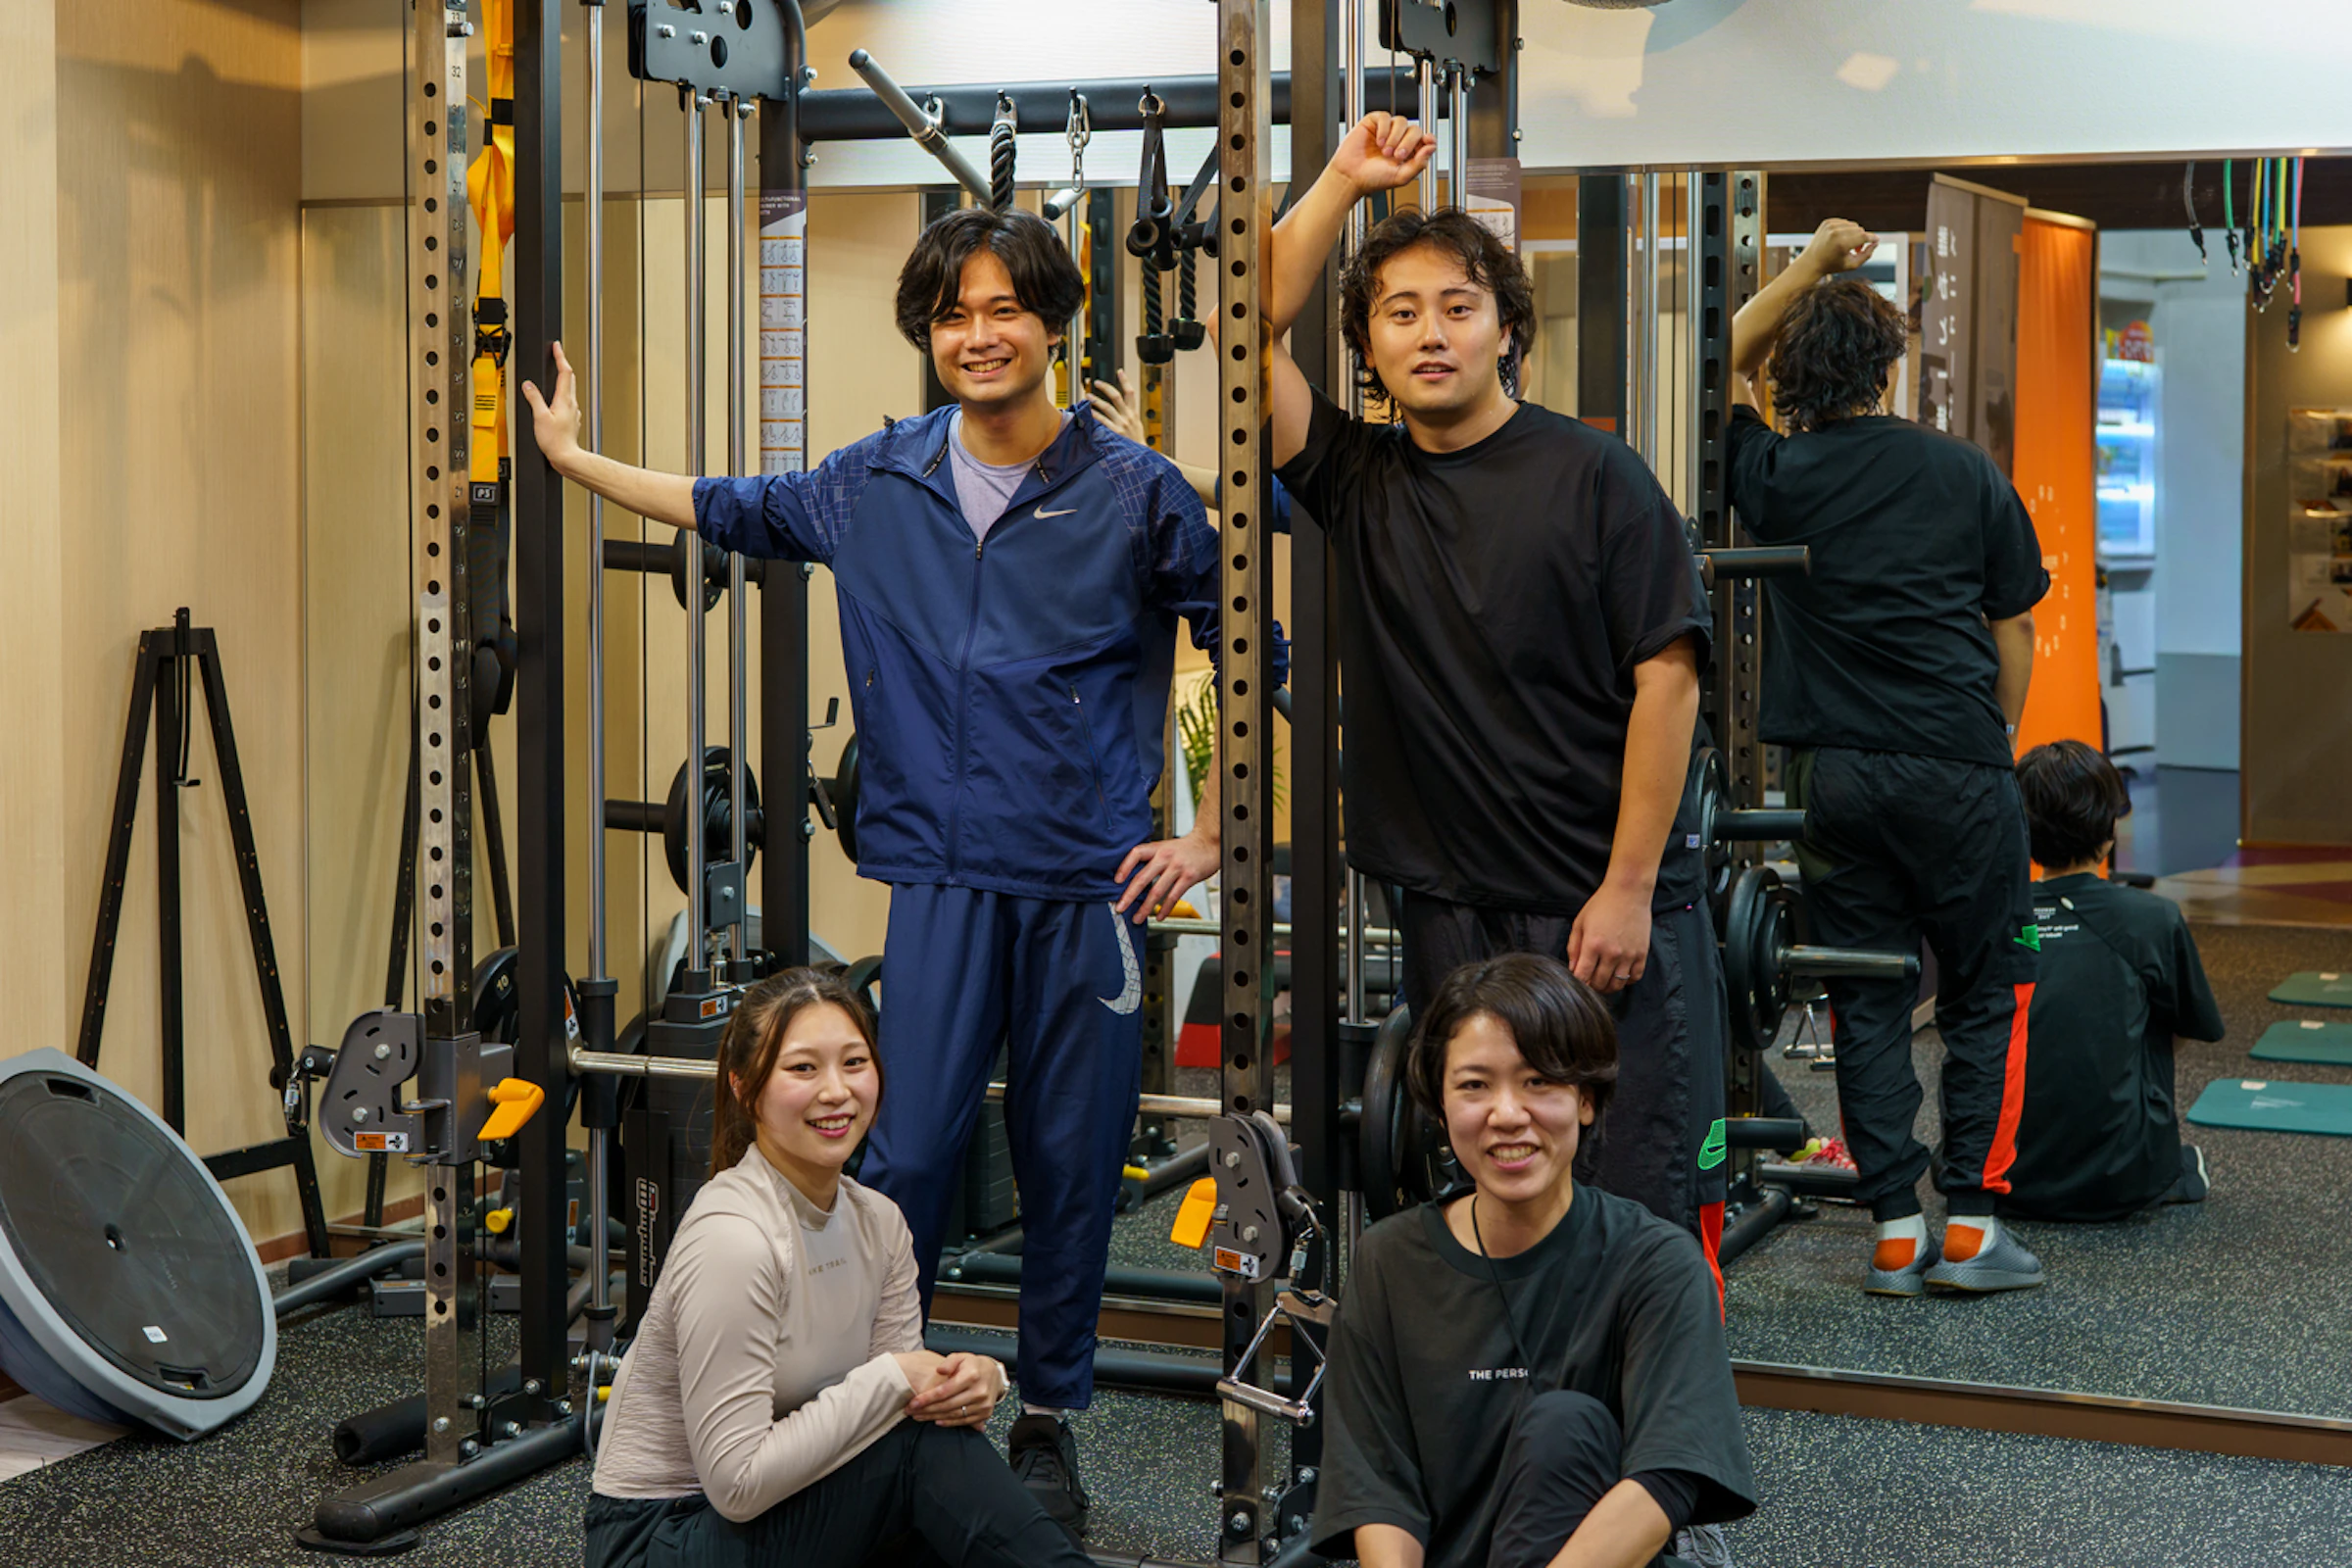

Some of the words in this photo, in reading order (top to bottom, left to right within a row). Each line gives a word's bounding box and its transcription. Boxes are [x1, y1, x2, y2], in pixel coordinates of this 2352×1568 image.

[451, 65, 462, 78] 32
[496, 973, 510, 992] 10
[1468, 1369, 1493, 1381] THE
